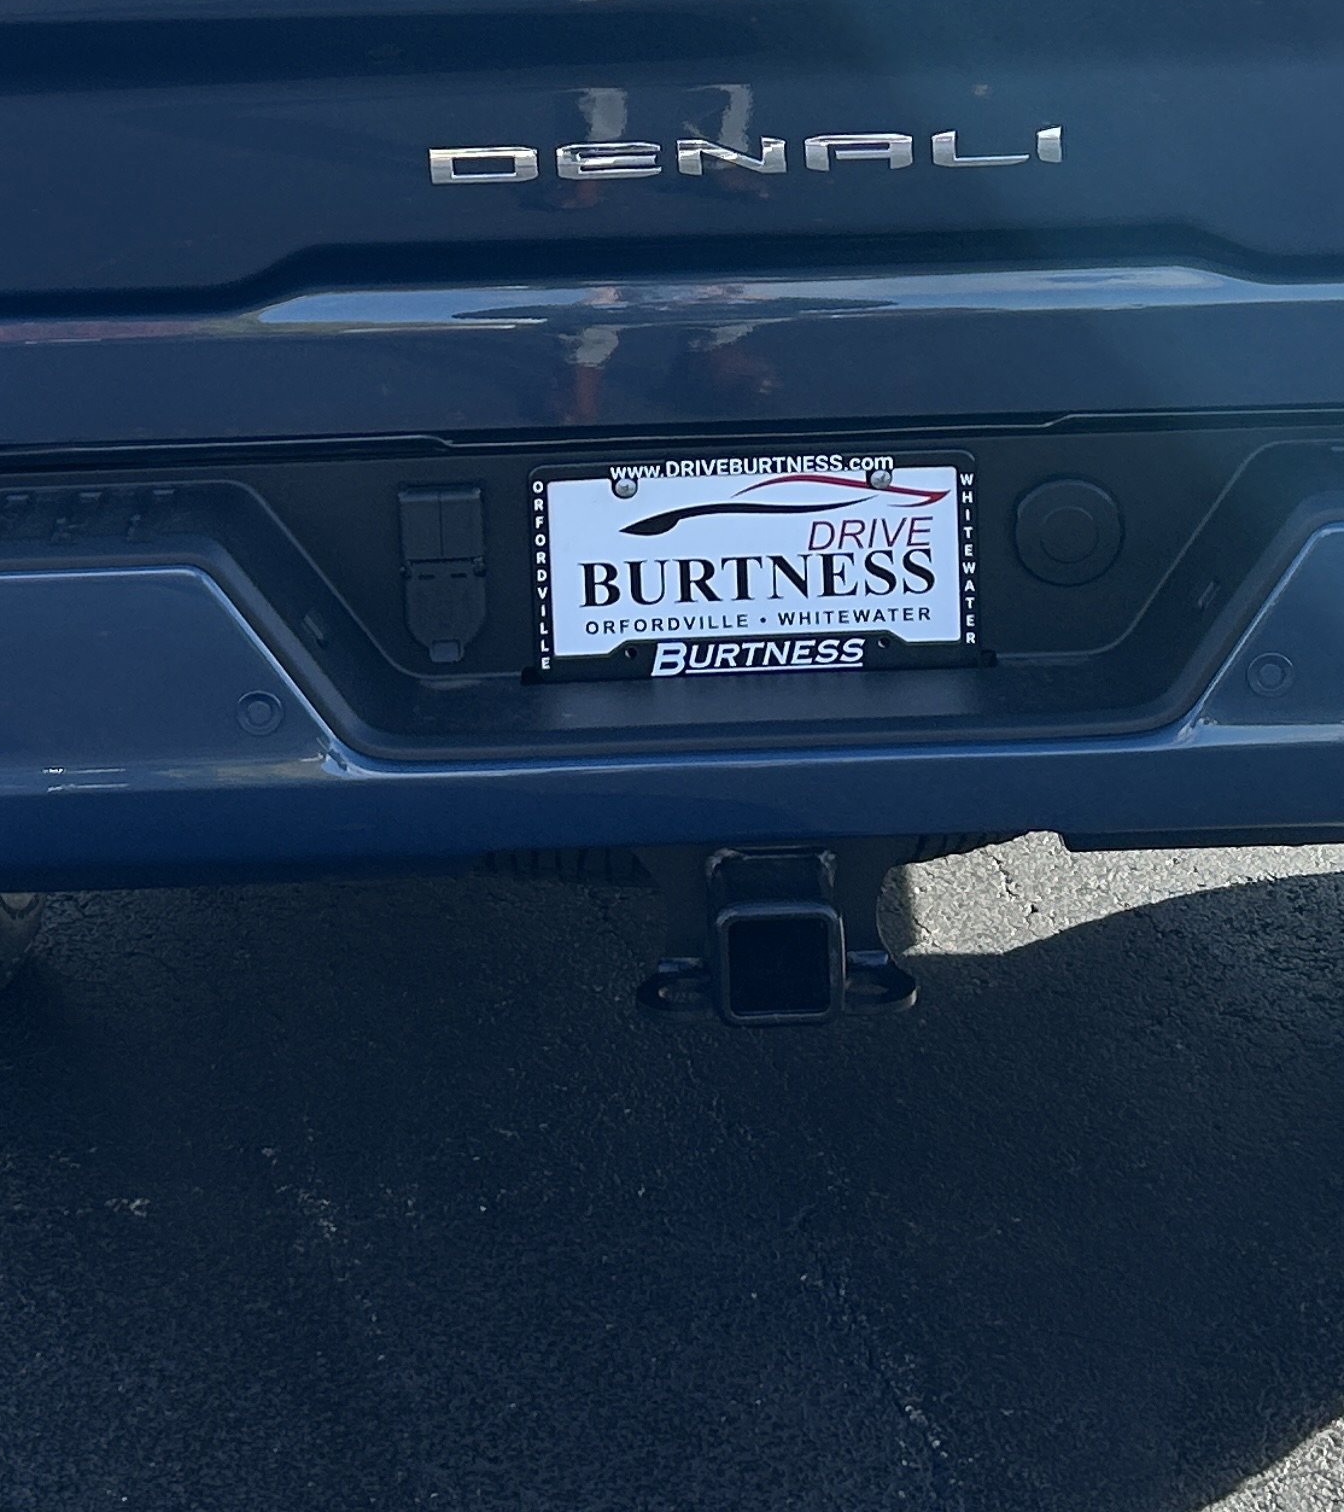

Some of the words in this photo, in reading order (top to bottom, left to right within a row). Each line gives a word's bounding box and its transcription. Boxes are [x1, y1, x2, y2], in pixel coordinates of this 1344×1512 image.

[429, 125, 1063, 184] DENALI
[610, 454, 894, 479] www.DRIVEBURTNESS.com
[807, 515, 935, 551] DRIVE
[532, 481, 551, 670] ORFORDVILLE
[578, 548, 937, 608] BURTNESS
[959, 473, 978, 645] WHITEWATER
[585, 613, 749, 636] ORFORDVILLE
[778, 606, 932, 626] WHITEWATER
[651, 637, 866, 677] BURTNESS
